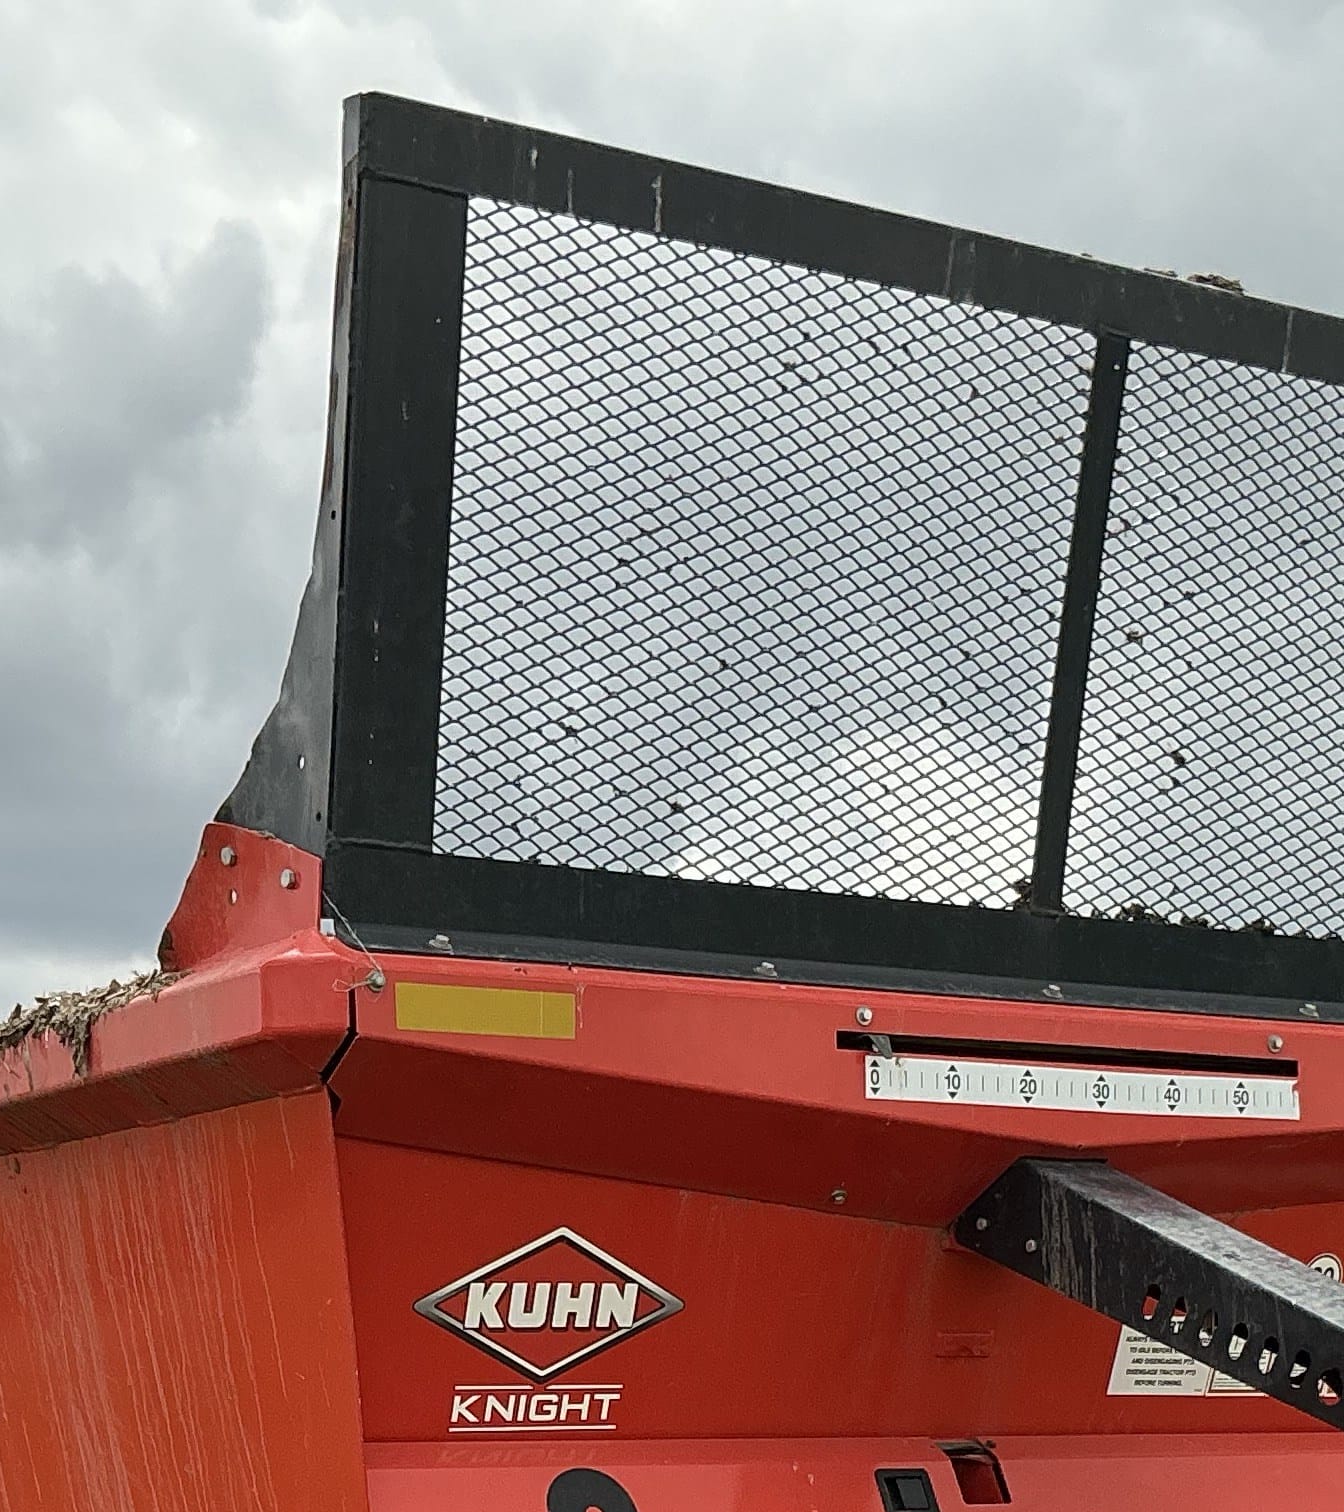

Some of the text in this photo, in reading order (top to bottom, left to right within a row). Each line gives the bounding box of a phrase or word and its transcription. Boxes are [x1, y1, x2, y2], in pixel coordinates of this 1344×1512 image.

[870, 1070, 1250, 1106] 0 10 20 30 40 50
[463, 1282, 639, 1329] KUHN
[450, 1393, 621, 1423] KNIGHT
